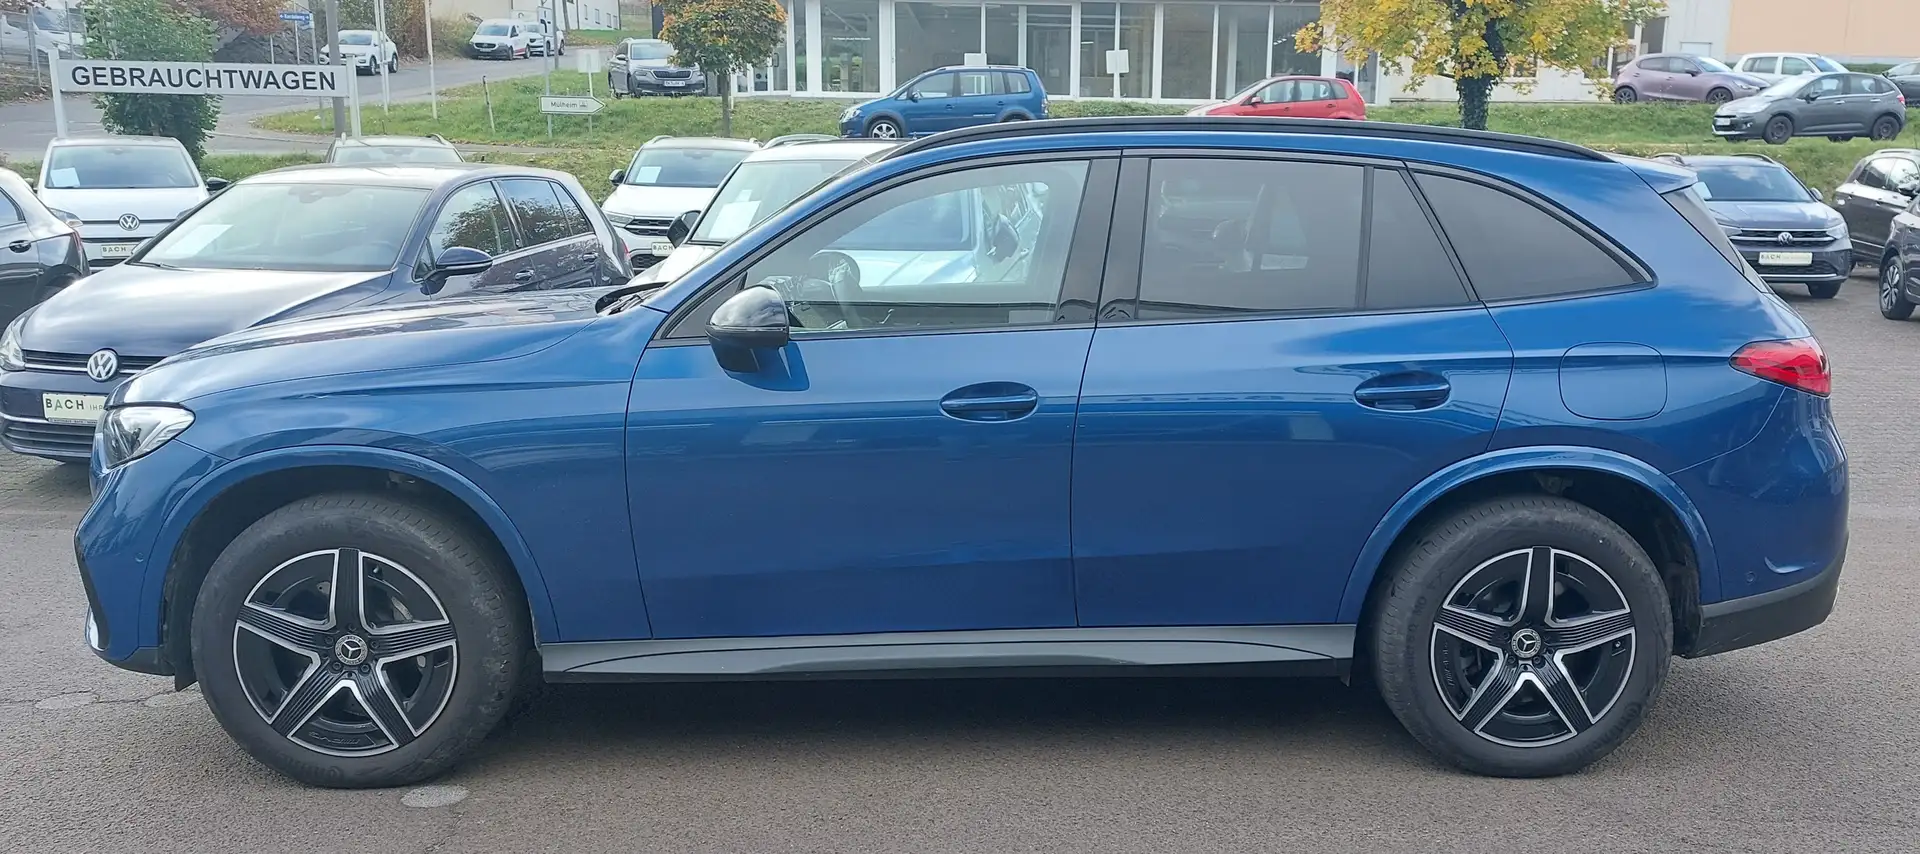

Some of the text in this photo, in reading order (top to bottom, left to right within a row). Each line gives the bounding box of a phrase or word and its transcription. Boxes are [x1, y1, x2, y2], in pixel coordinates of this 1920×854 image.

[71, 66, 336, 91] GEBRAUCHTWAGEN
[87, 350, 117, 380] VW
[45, 398, 84, 411] BACH
